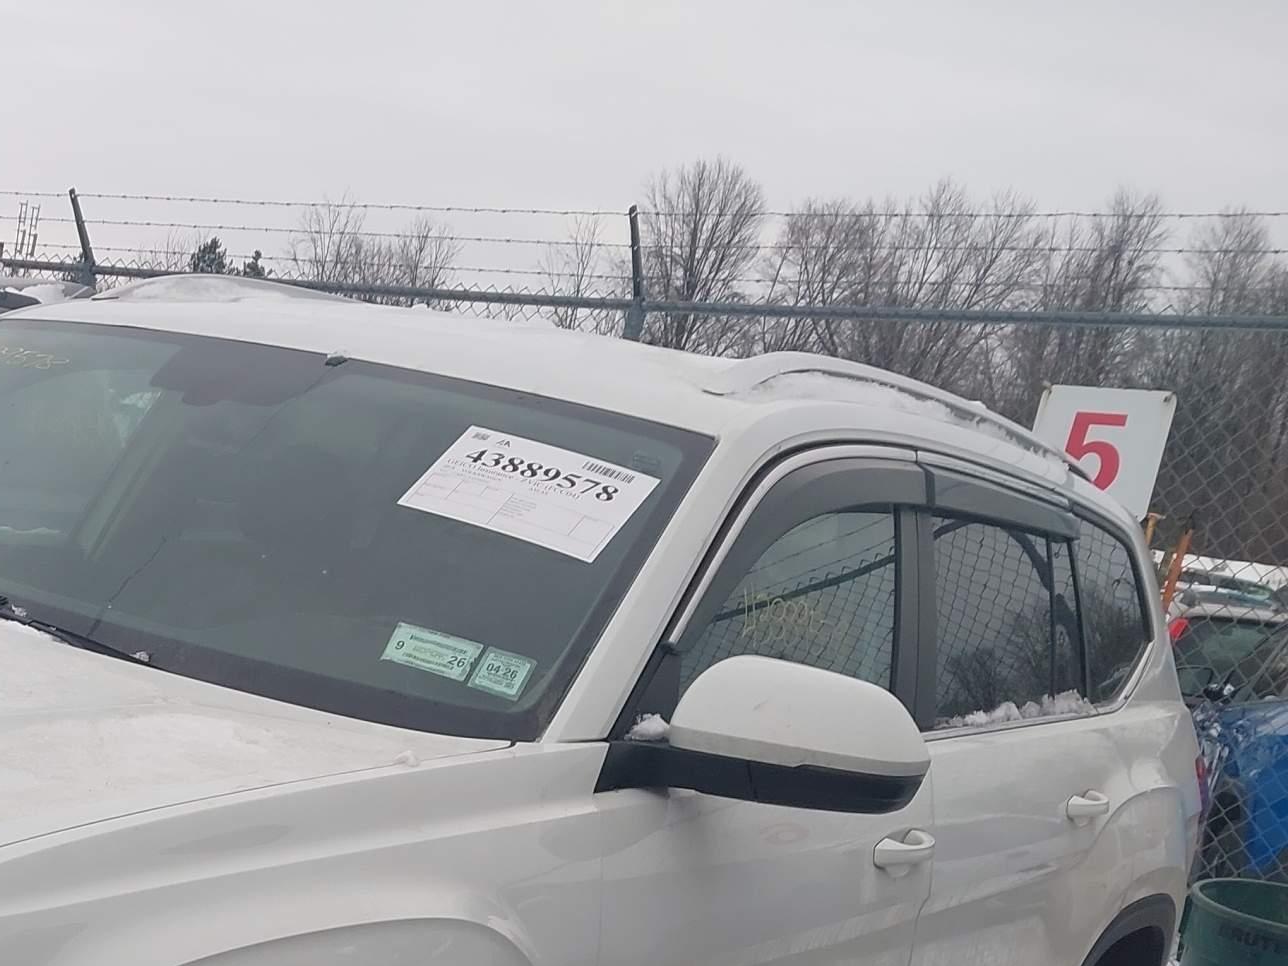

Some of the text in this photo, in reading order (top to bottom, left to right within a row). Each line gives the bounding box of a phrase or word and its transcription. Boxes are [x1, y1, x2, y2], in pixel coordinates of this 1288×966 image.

[1064, 411, 1129, 492] 5
[465, 448, 619, 502] 43889578
[394, 640, 405, 650] 9
[447, 655, 467, 668] 26
